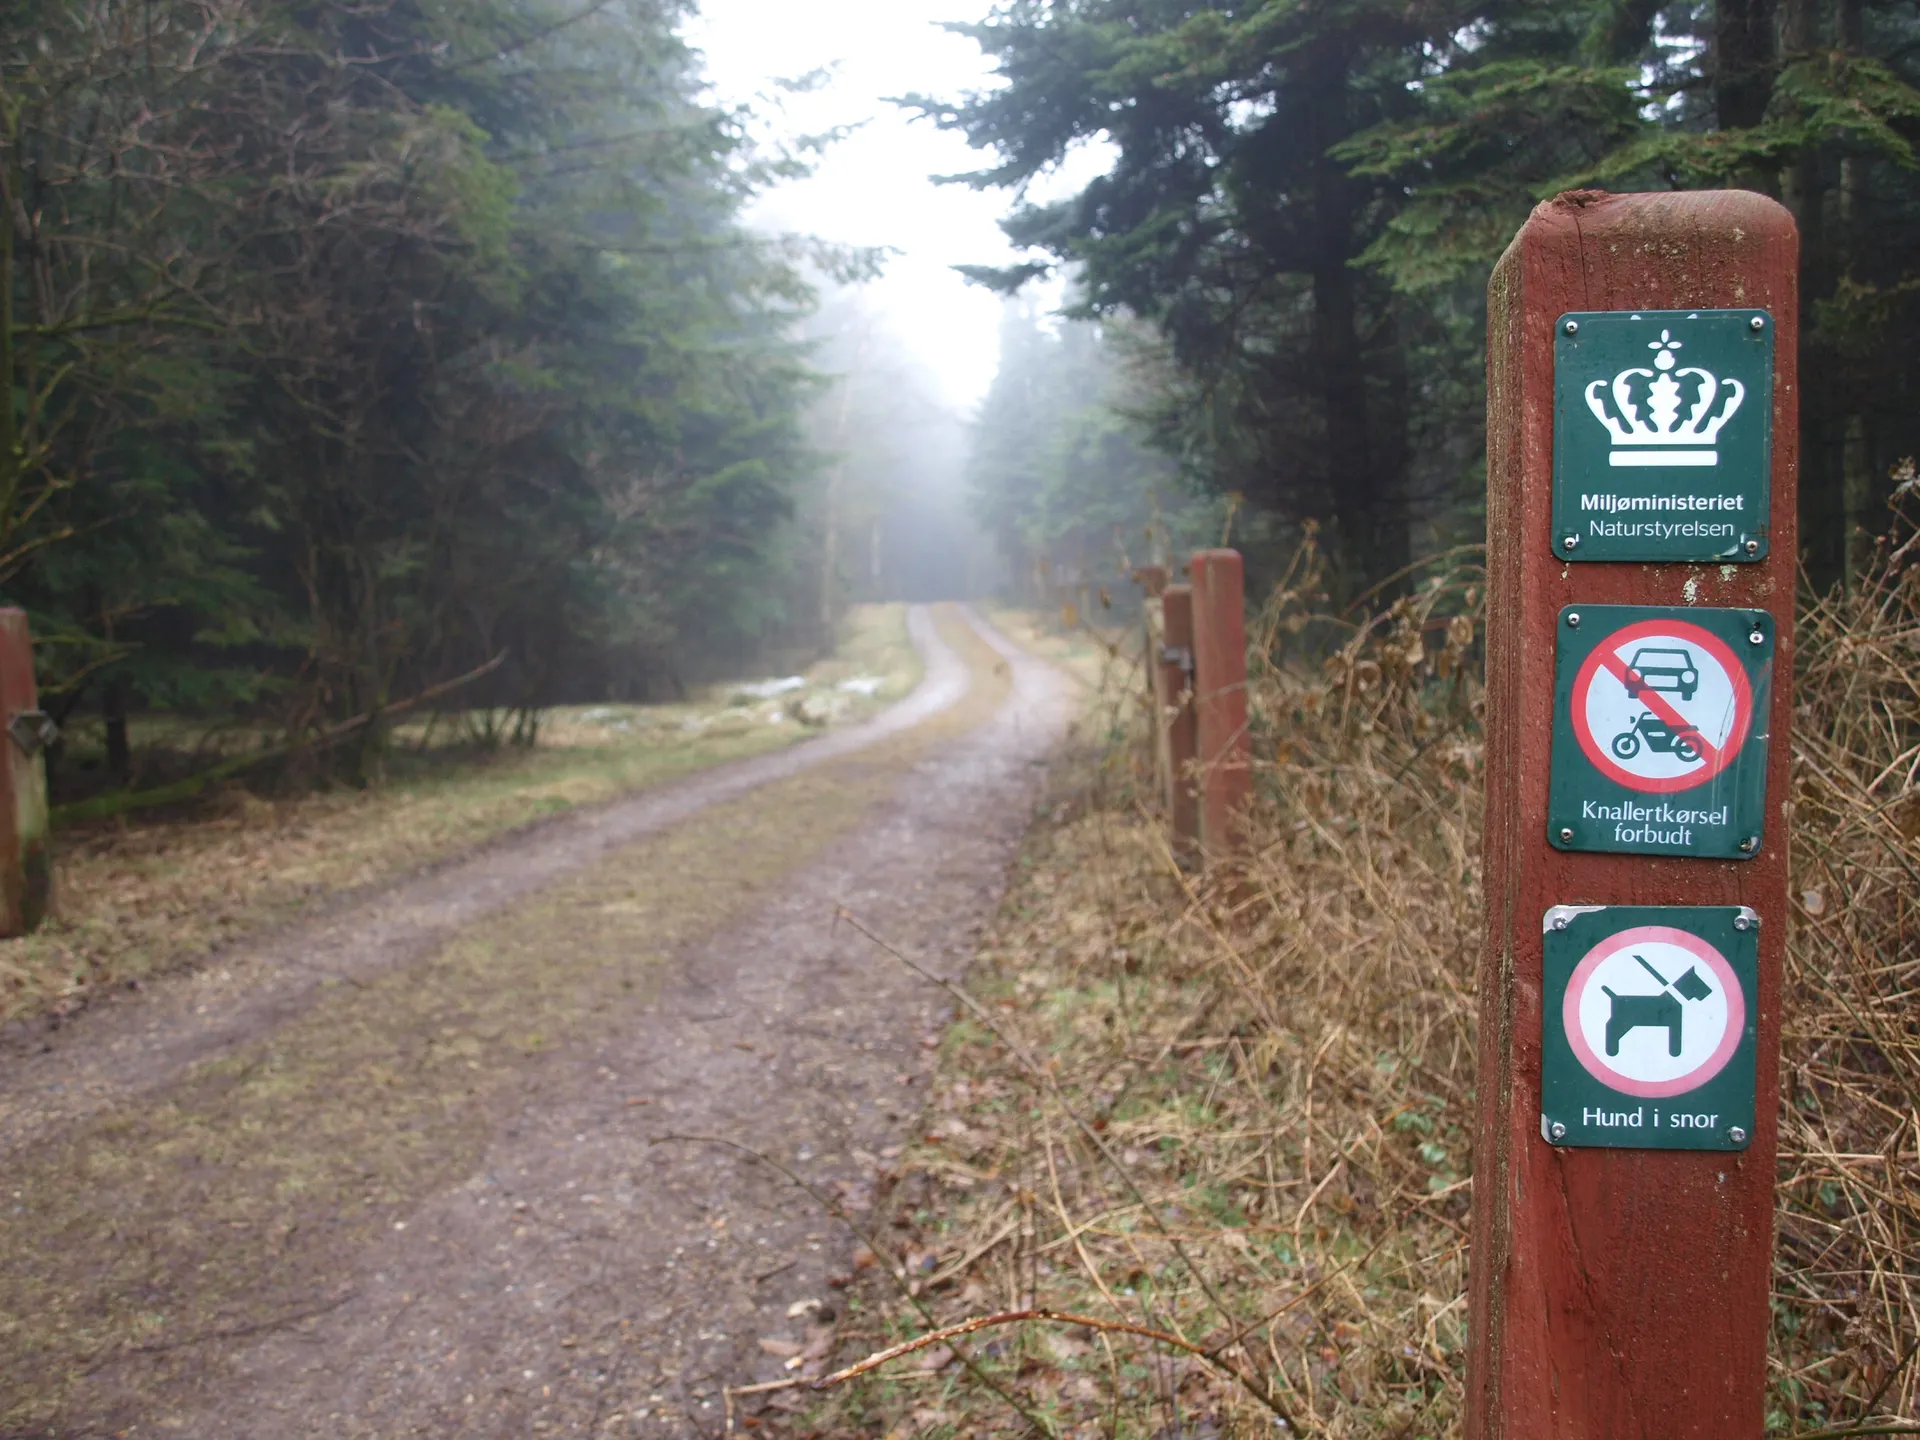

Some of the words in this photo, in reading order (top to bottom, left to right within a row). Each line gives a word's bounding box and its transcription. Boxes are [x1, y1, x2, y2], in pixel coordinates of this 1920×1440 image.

[1580, 493, 1744, 514] Miljøministeriet
[1589, 520, 1734, 540] Naturstyrelsen
[1582, 800, 1728, 826] Knallertkørsel
[1614, 822, 1692, 846] forbudt
[1583, 1106, 1643, 1128] Hund
[1653, 1108, 1659, 1128] i
[1670, 1113, 1719, 1129] snor
